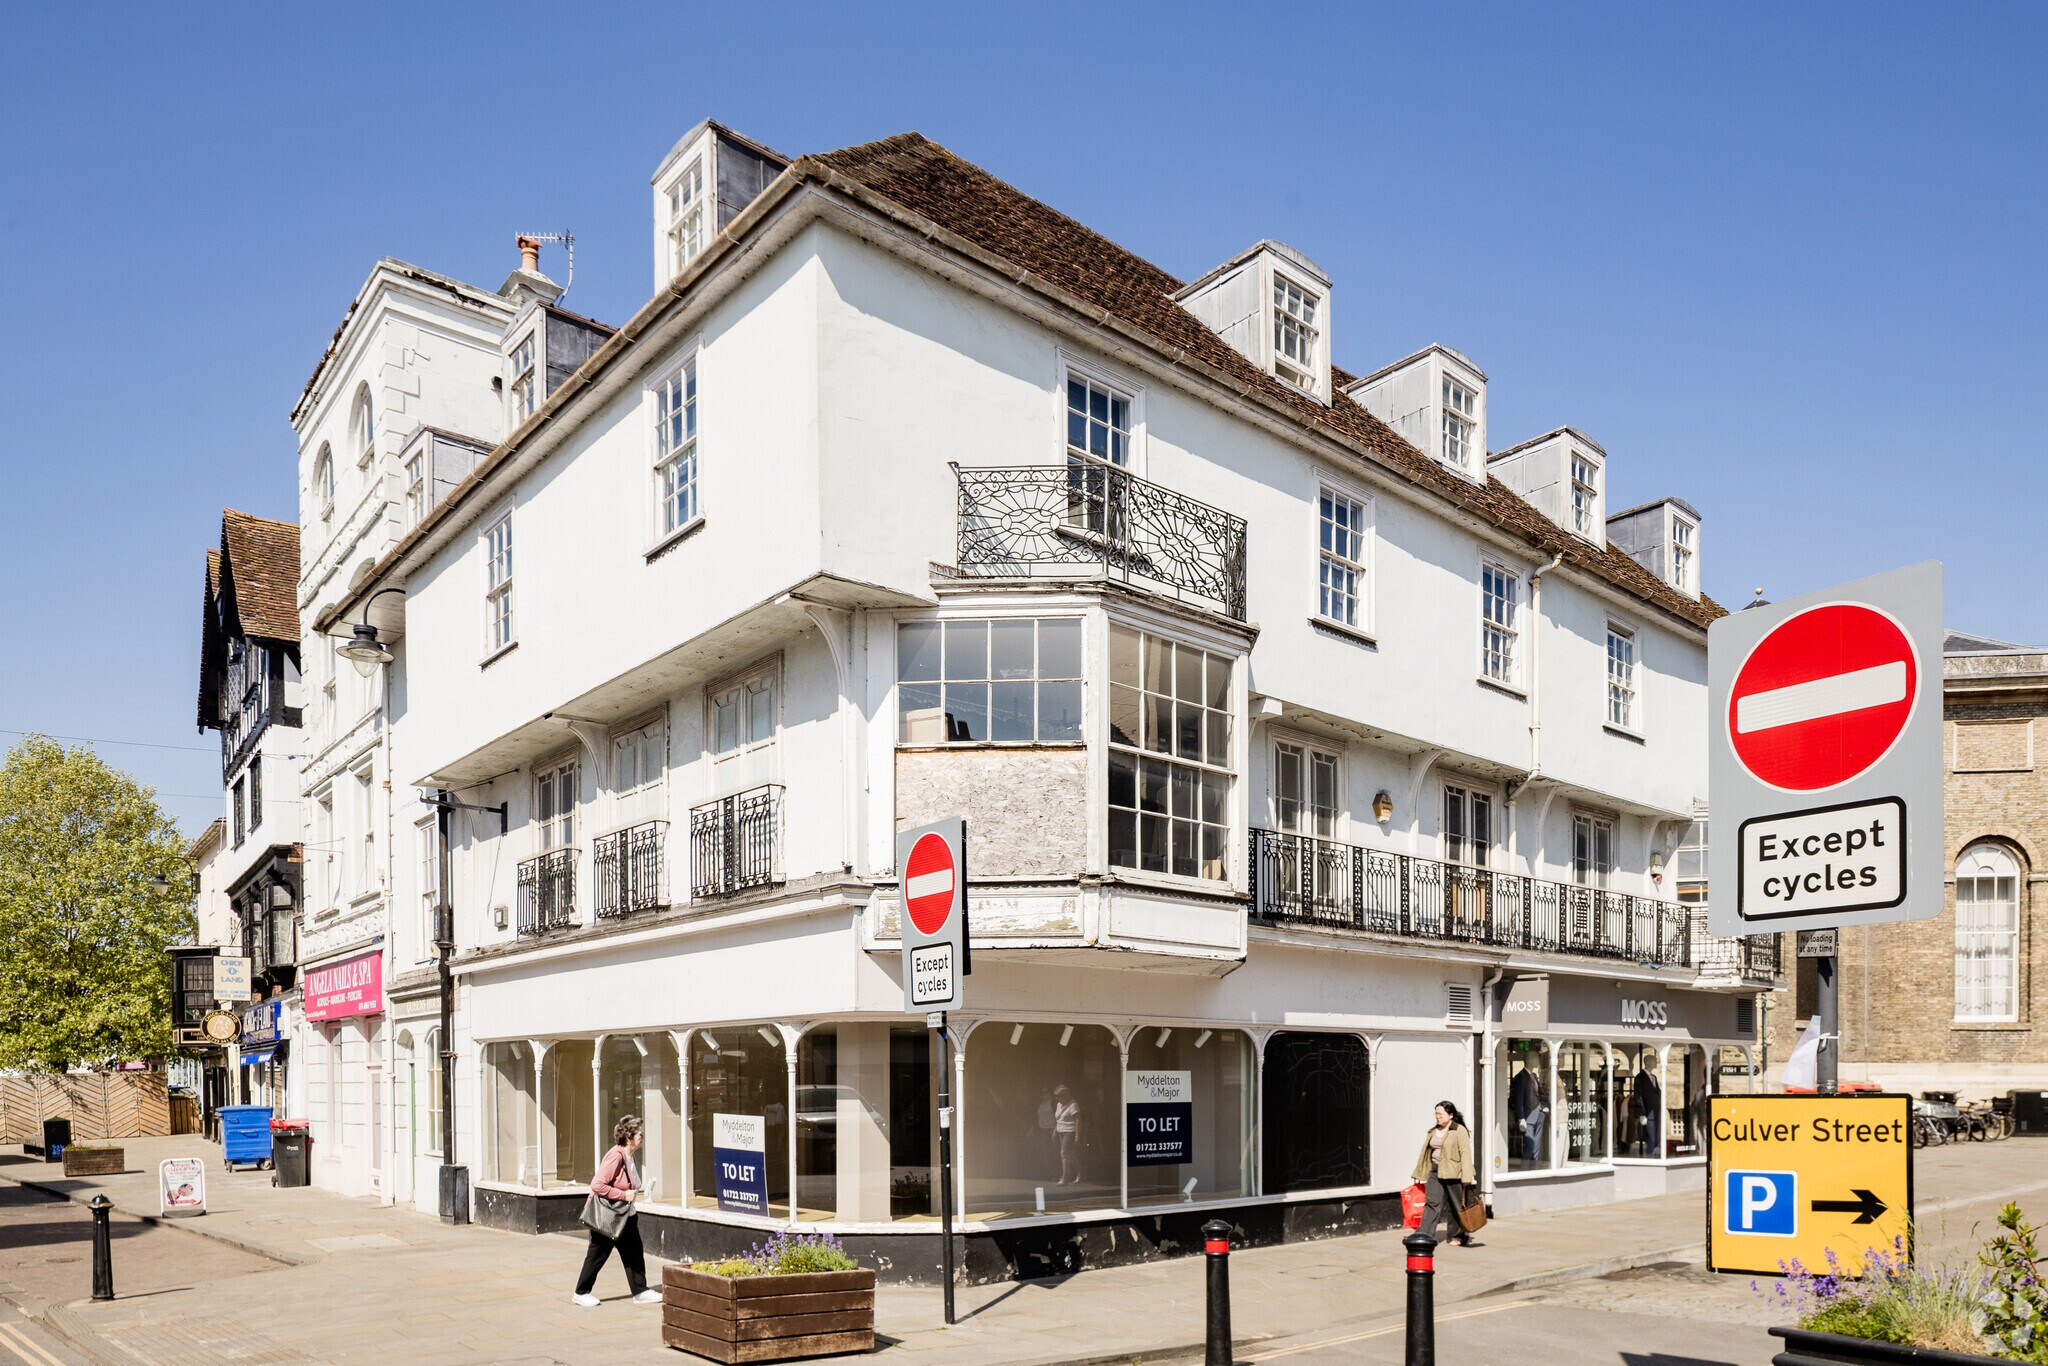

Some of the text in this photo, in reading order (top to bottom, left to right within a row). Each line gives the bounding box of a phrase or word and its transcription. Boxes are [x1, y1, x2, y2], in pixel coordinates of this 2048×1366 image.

[1759, 819, 1885, 862] Except
[1763, 863, 1877, 901] cycles
[1801, 934, 1832, 943] No loading
[1807, 946, 1817, 954] any
[916, 954, 948, 973] Except
[309, 960, 372, 997] ANGELA NAILS & SPA
[918, 976, 946, 995] cycles
[1506, 1000, 1541, 1012] MOSS
[1621, 999, 1667, 1025] MOSS
[1137, 1075, 1180, 1088] Myddelton
[1151, 1087, 1180, 1100] &Major
[1568, 1102, 1597, 1113] SPRING
[722, 1119, 754, 1133] Myddelton
[1138, 1117, 1180, 1132] TO LET
[1568, 1118, 1596, 1130] SUMMER
[1713, 1118, 1903, 1143] Culver Street
[732, 1132, 754, 1147] &Major
[1572, 1135, 1592, 1146] 2025
[1136, 1142, 1182, 1152] 01722 337577
[722, 1163, 755, 1182] TO LET
[723, 1189, 759, 1203] 01722 337577
[1742, 1176, 1777, 1229] P
